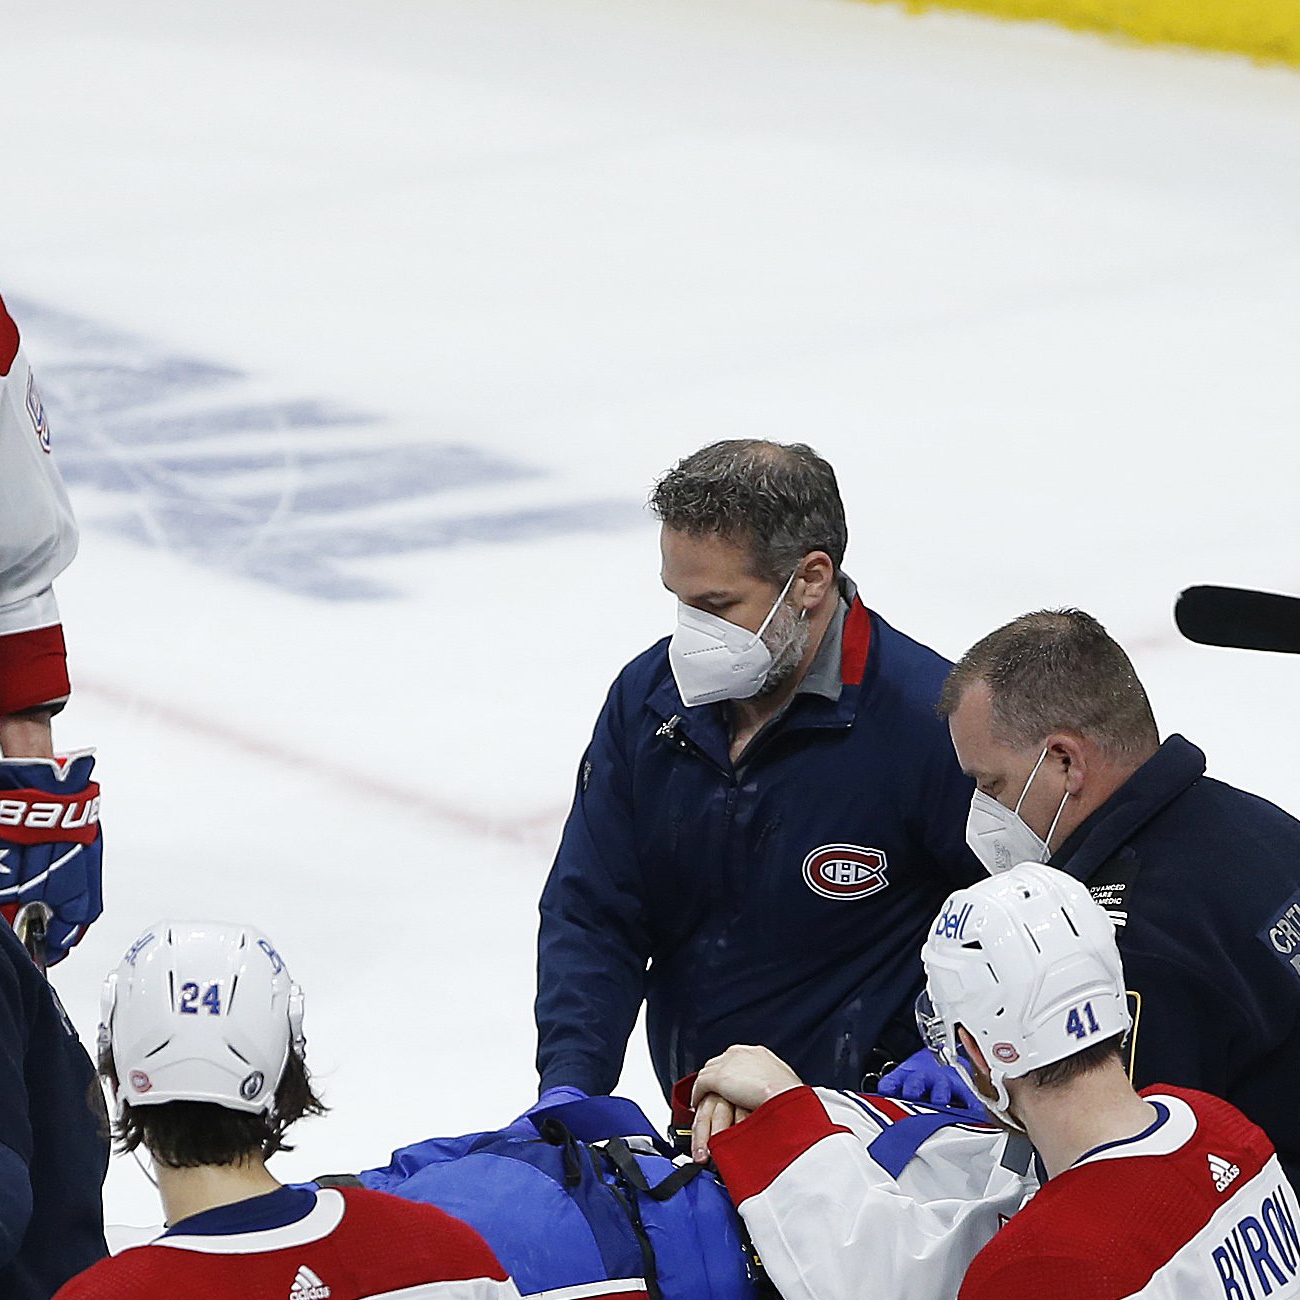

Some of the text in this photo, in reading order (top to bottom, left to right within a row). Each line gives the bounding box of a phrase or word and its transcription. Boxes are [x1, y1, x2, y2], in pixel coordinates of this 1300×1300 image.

[1089, 883, 1126, 894] DVANCED
[1092, 891, 1113, 899] CARE
[935, 900, 973, 941] Bell
[180, 982, 221, 1016] 24
[1066, 1001, 1101, 1041] 41
